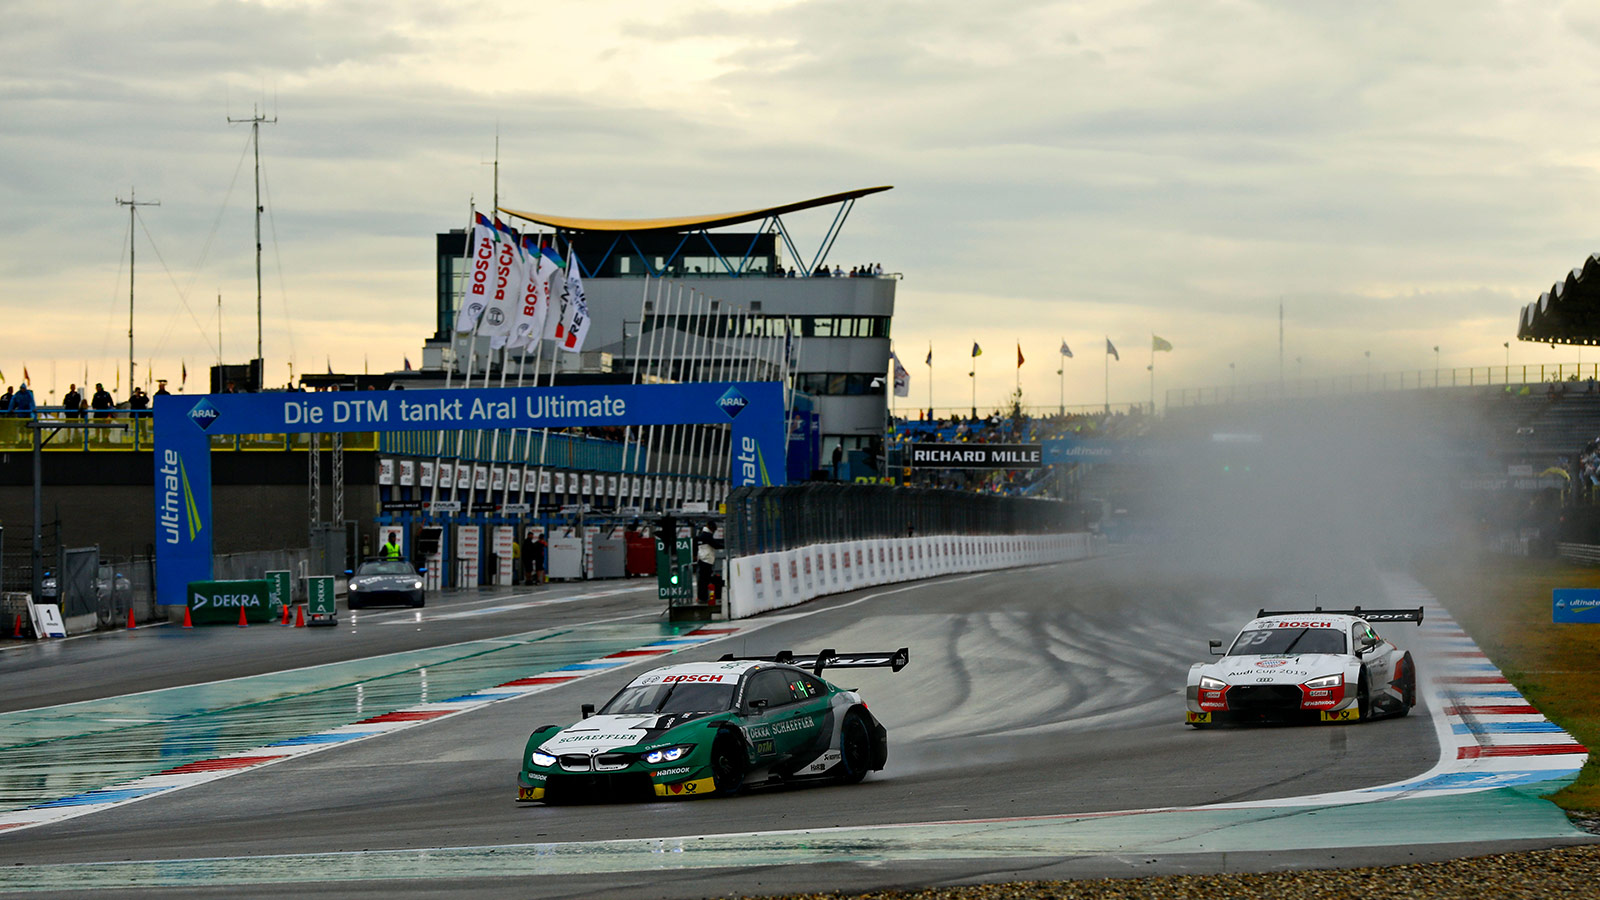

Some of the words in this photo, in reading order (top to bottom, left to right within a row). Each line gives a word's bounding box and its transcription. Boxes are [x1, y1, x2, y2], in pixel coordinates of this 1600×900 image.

[472, 237, 492, 295] BOSCH
[720, 398, 745, 406] ARAL
[191, 409, 217, 418] ARAL
[284, 401, 323, 424] Die
[333, 400, 388, 423] DTM
[399, 398, 463, 421] tankt
[469, 396, 516, 420] Aral
[526, 394, 626, 418] Ultimate
[914, 450, 986, 462] RICHARD
[992, 450, 1040, 463] MILLE
[160, 448, 179, 545] ultimate
[317, 579, 325, 603] DEKRA
[213, 594, 260, 607] DEKRA
[46, 609, 53, 621] 1
[1236, 630, 1273, 646] 33
[662, 674, 723, 683] BOSCH
[1227, 668, 1254, 677] Audi
[772, 716, 815, 735] SCHAEFFLER
[558, 734, 638, 744] SCHAEFFLER
[750, 727, 771, 739] DEKRA
[758, 742, 773, 753] DTM
